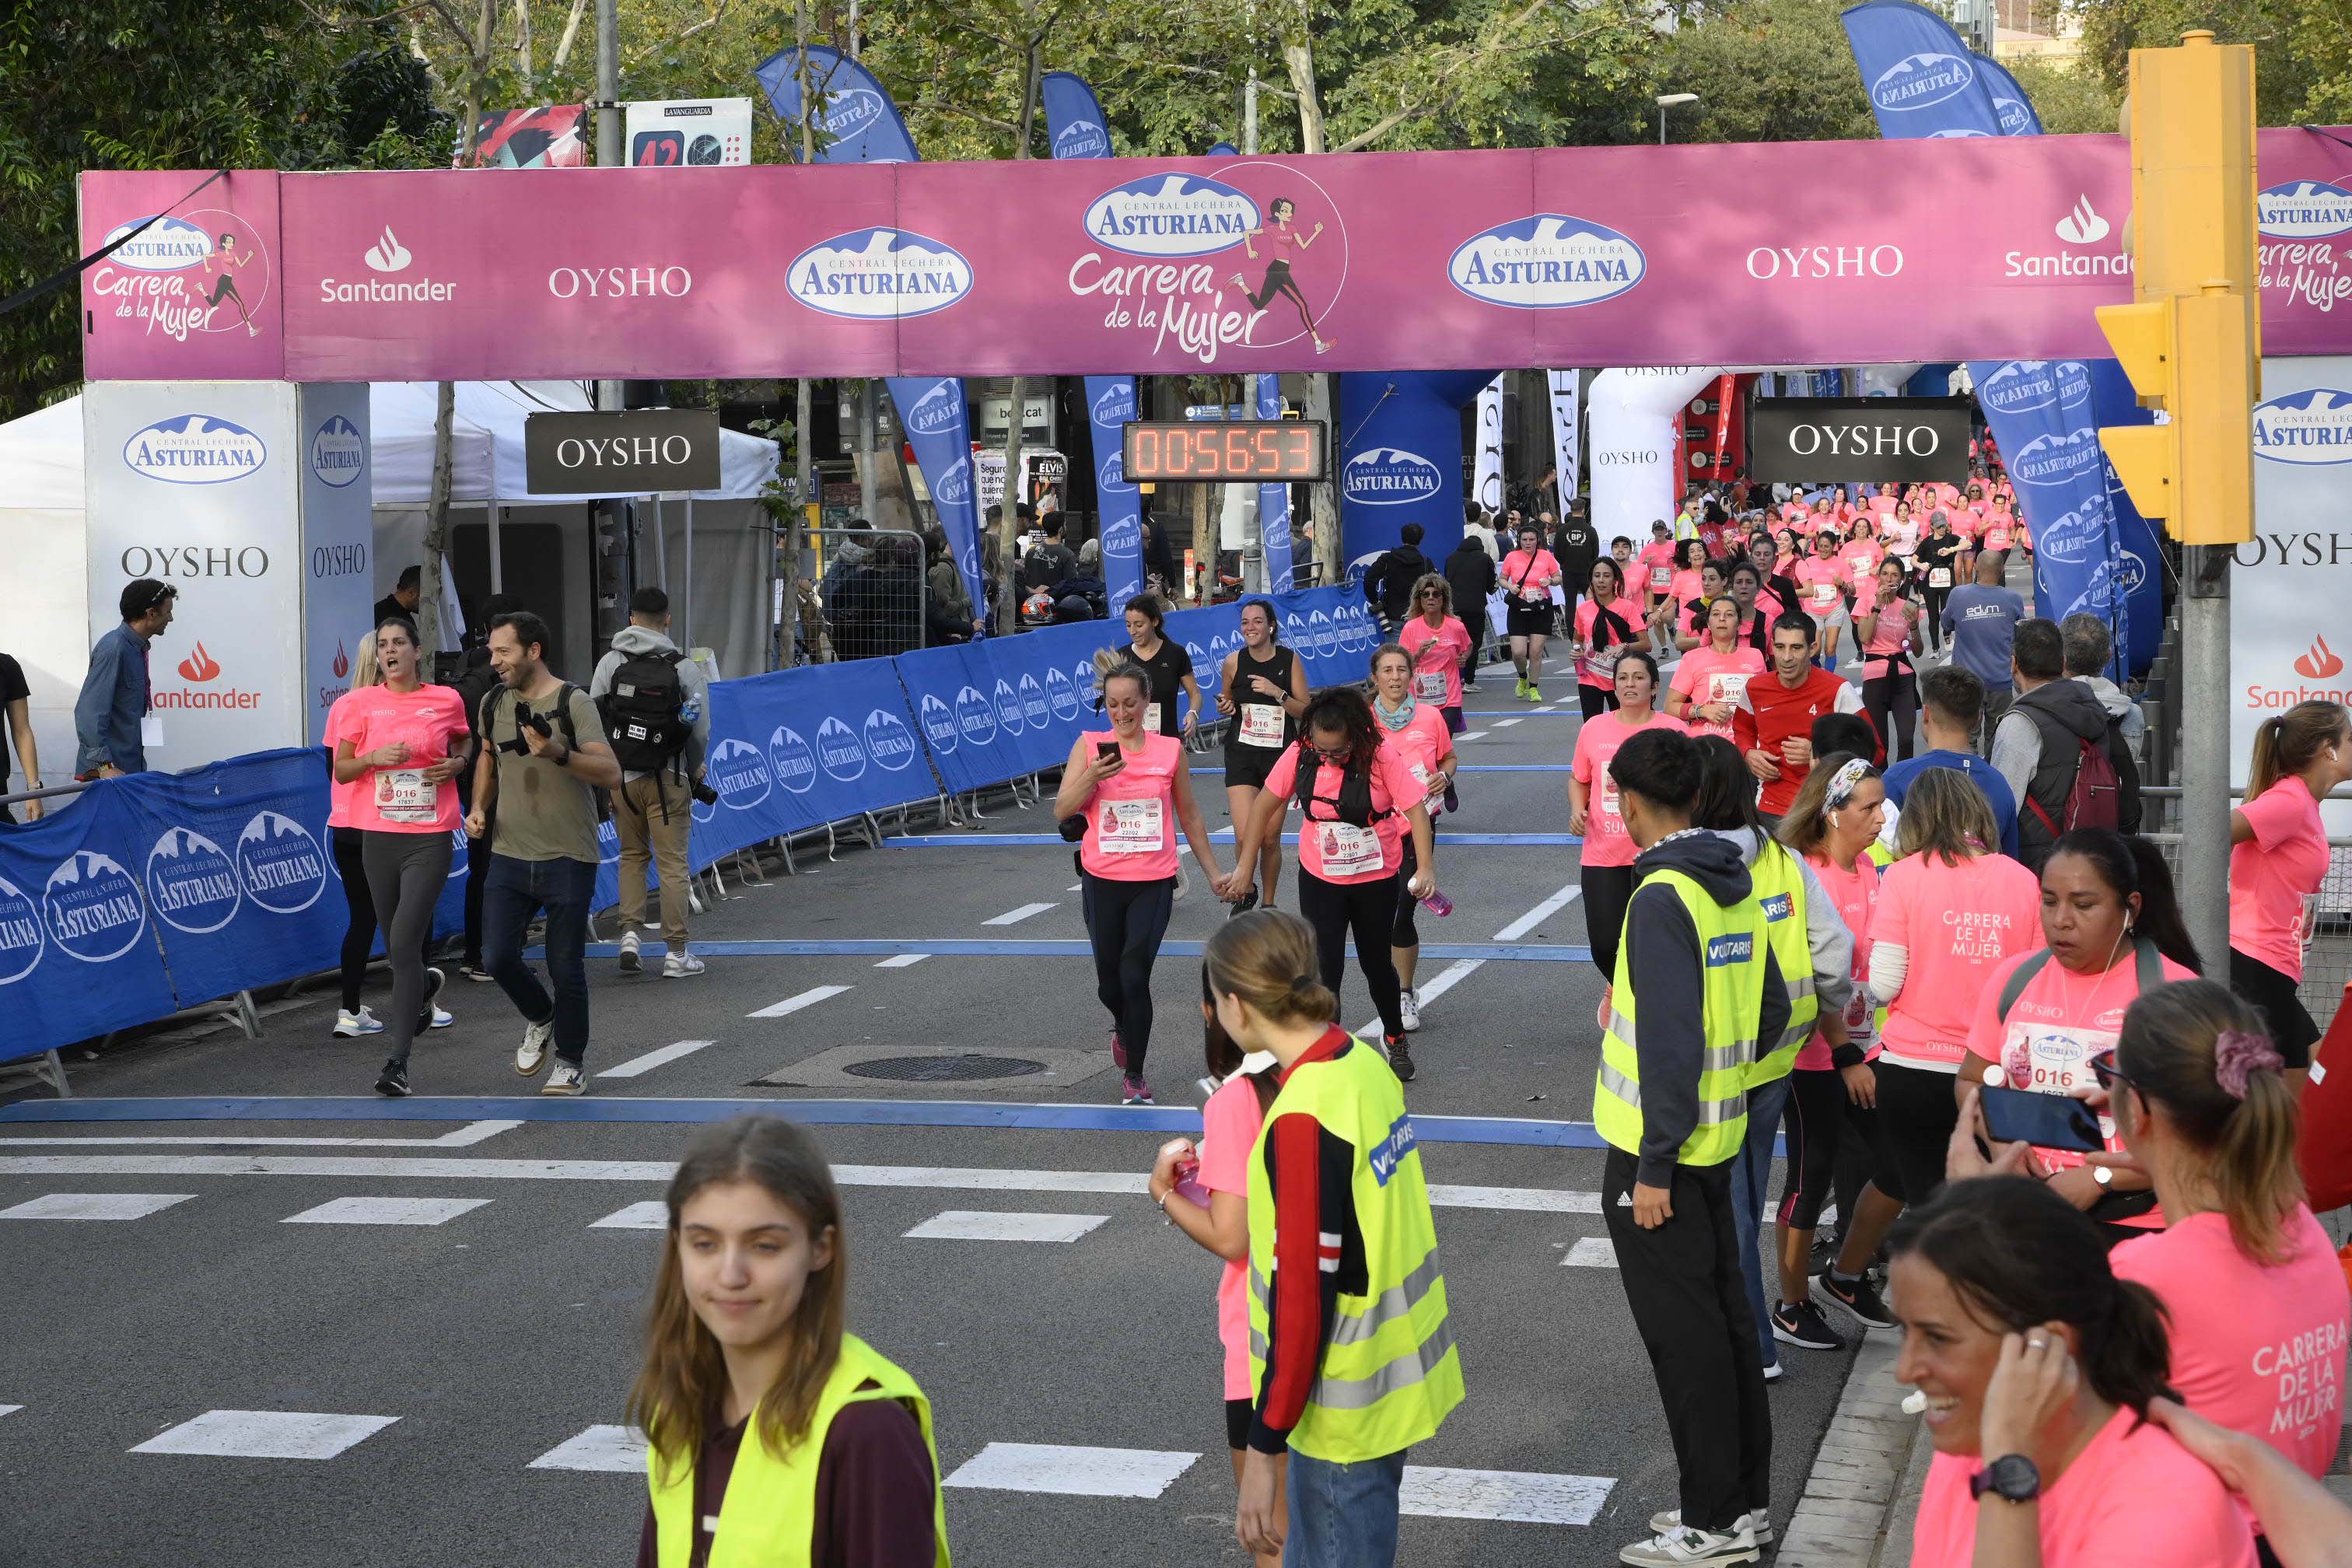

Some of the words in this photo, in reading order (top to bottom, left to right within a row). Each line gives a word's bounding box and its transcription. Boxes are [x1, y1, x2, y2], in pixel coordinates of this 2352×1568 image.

[1124, 201, 1179, 210] CENTRAL
[1184, 201, 1242, 210] LECHERA
[1097, 205, 1246, 236] ASTURIANA
[829, 259, 887, 268] CENTRAL
[1493, 247, 1555, 257] CENTRAL
[1561, 246, 1624, 255] LECHERA
[1746, 245, 1904, 279] OYSHO
[2004, 250, 2134, 277] Santand
[2259, 243, 2332, 265] arrera
[801, 261, 959, 296] ASTURIANA
[1069, 253, 1213, 296] Carrera
[1463, 251, 1631, 285] ASTURIANA
[93, 268, 184, 296] Carrera
[321, 278, 456, 303] Santander
[549, 266, 691, 298] OYSHO
[2277, 266, 2291, 288] la
[2287, 262, 2352, 312] Muje
[116, 299, 133, 318] de
[137, 298, 149, 317] la
[146, 294, 219, 341] Mujer
[1104, 298, 1132, 328] de
[1138, 298, 1156, 328] la
[1152, 291, 1269, 364] Mujer
[135, 440, 257, 467] ASTURIANA
[557, 435, 691, 467] OYSHO
[1136, 429, 1310, 473] 00:56:53
[1789, 425, 1939, 457] OYSHO
[316, 441, 361, 469] ASTURIANA
[1039, 464, 1063, 473] ELVIS
[1599, 450, 1657, 466] OYSHO
[1346, 471, 1433, 492] ASTURIANA
[121, 546, 268, 577] OYSHO
[313, 543, 365, 578] OYSHO
[2230, 532, 2352, 567] OYSH
[154, 688, 261, 709] antander
[1809, 703, 1818, 716] 4
[773, 754, 814, 779] ASTURIANA
[821, 743, 863, 768] ASTURIANA
[714, 766, 769, 796] ASTURIANA
[253, 845, 281, 859] CENTRAL
[1340, 842, 1360, 851] 016
[165, 863, 195, 877] CENTRAL
[244, 853, 323, 892] ASTURIANA
[156, 870, 236, 912] ASTURIANA
[1943, 909, 2011, 929] CARRERA
[1956, 926, 1973, 941] DE
[1979, 928, 1998, 943] LA
[1951, 940, 2002, 958] MUJER
[2020, 1001, 2063, 1018] OYSHO
[1927, 1041, 1967, 1055] OYSHO
[2035, 1043, 2079, 1057] ASTURIANA
[2035, 1069, 2073, 1087] 016
[2252, 1318, 2347, 1377] CARRERA
[2279, 1366, 2309, 1403] DE
[2313, 1356, 2334, 1389] LA
[2269, 1384, 2336, 1435] MUJER
